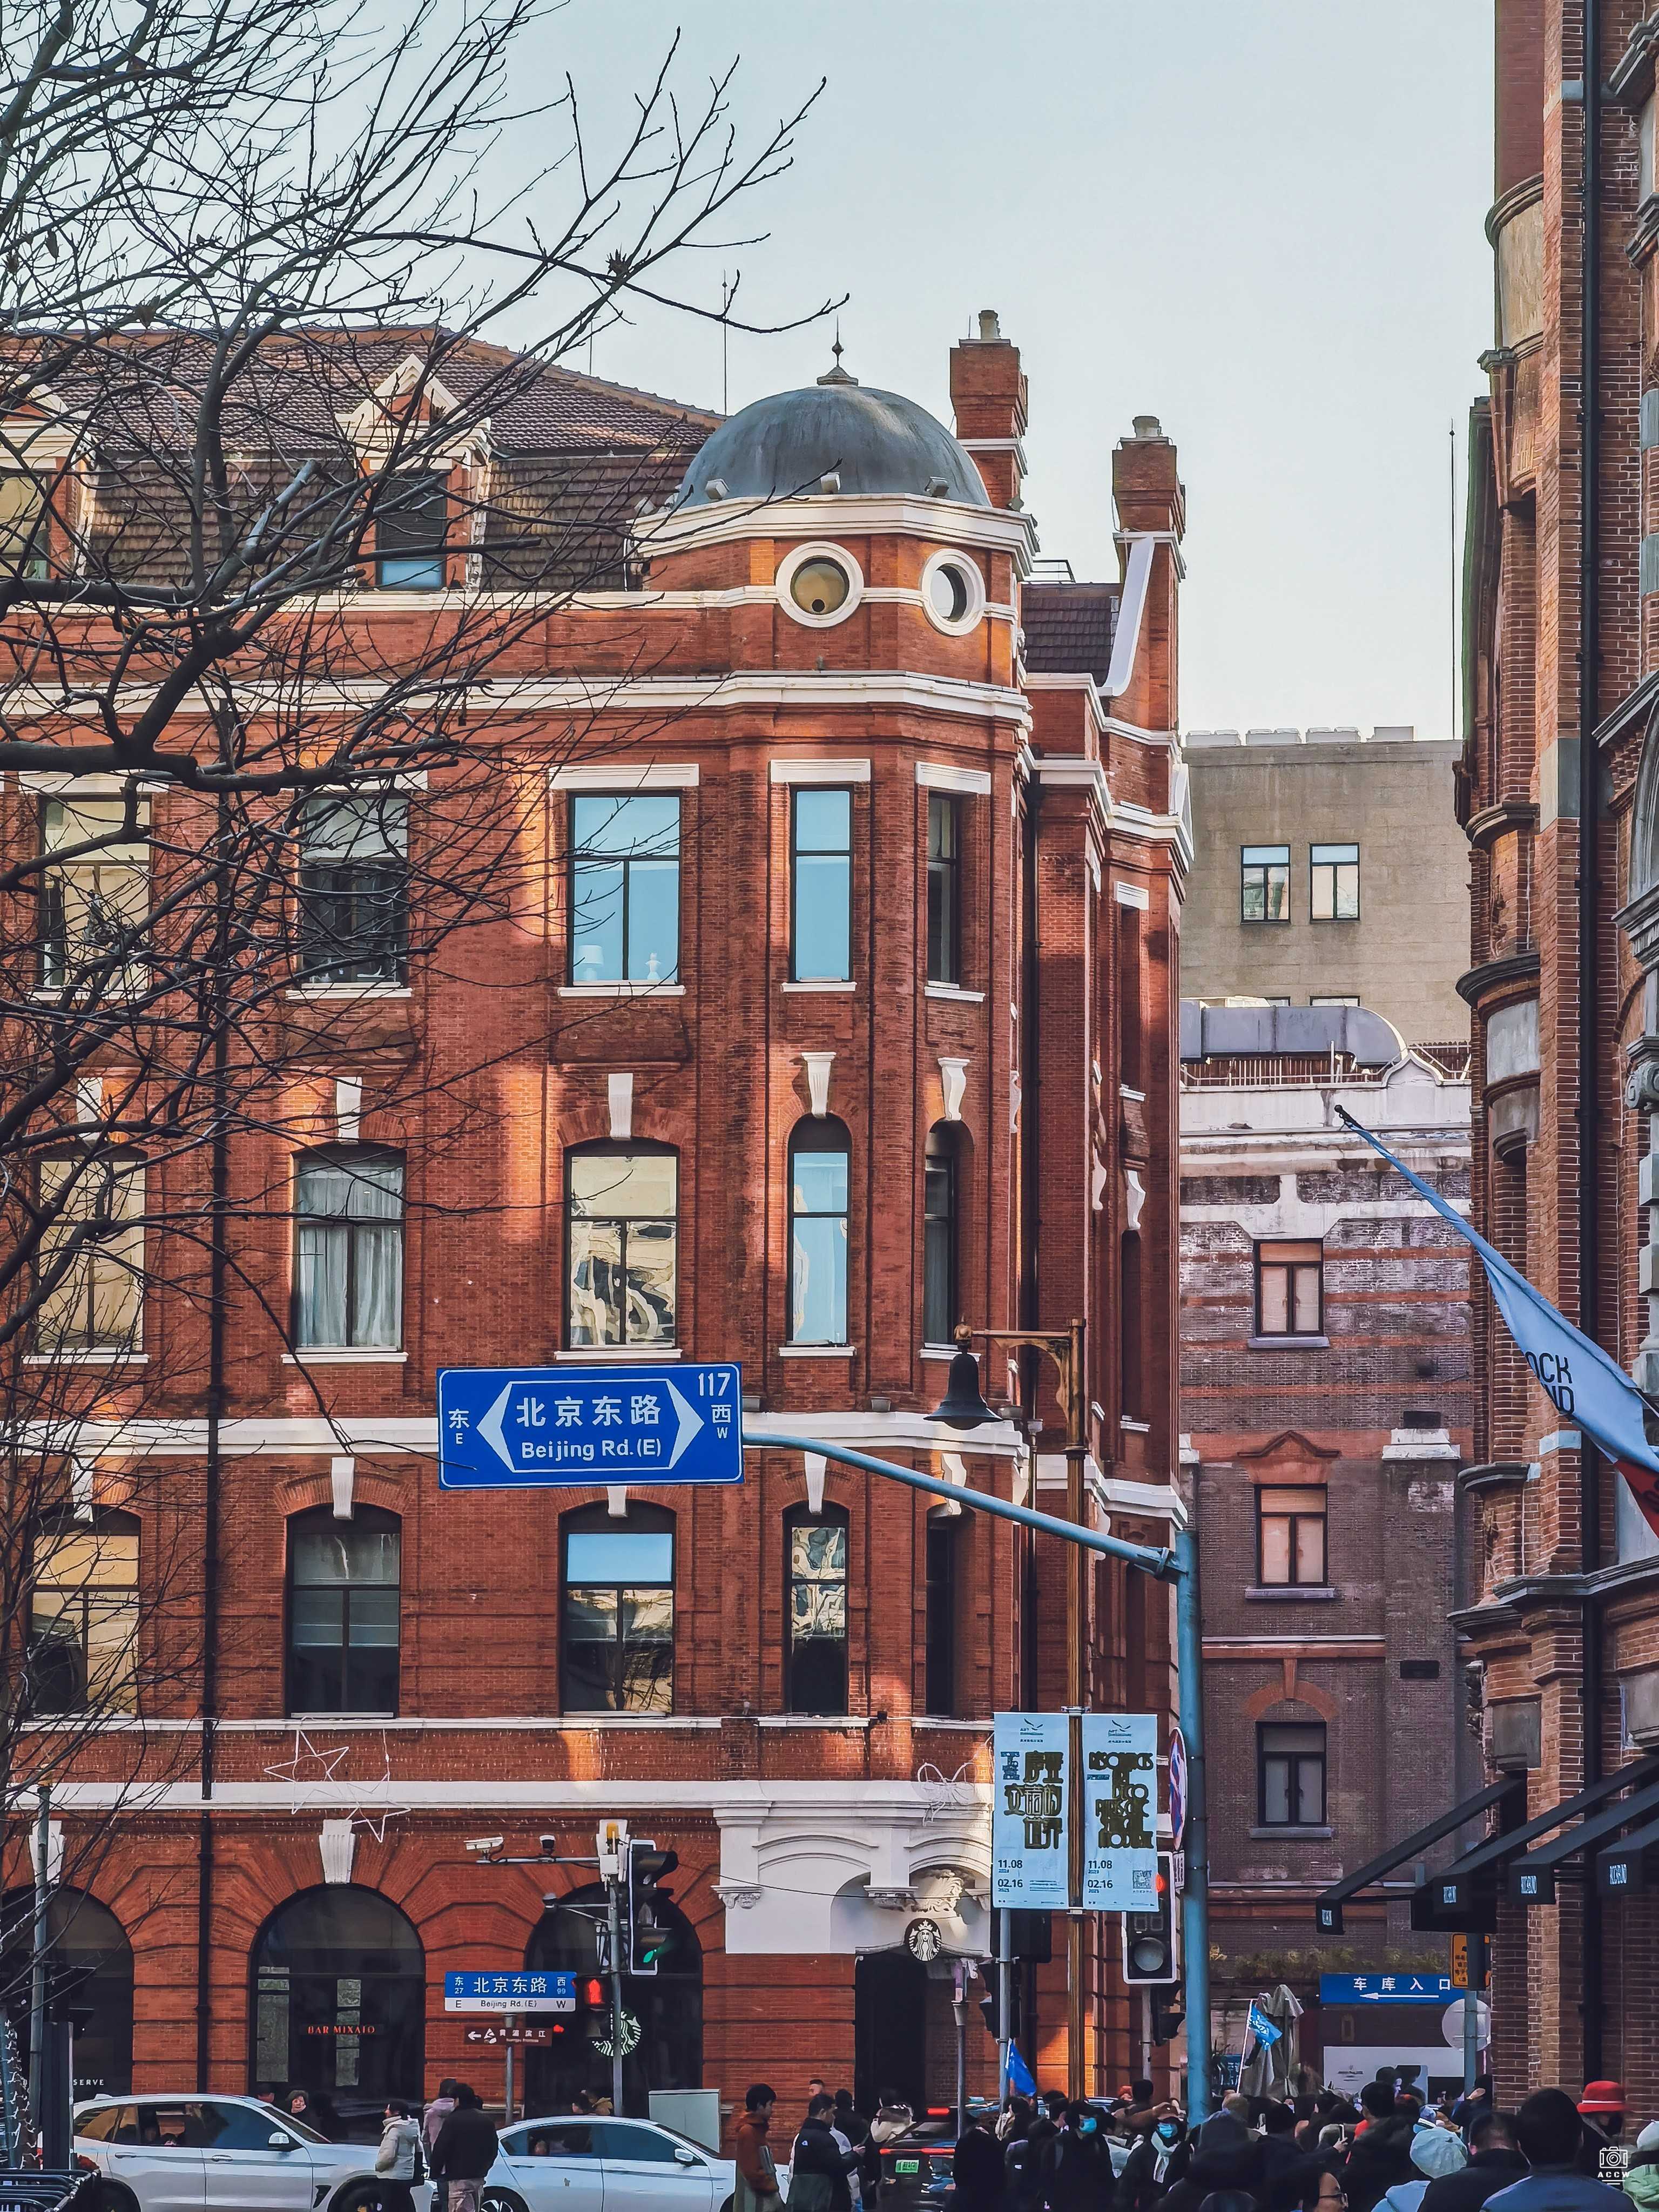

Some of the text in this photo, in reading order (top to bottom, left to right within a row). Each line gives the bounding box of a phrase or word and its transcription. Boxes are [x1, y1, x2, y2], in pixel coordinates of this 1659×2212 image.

[698, 1373, 730, 1397] 117
[516, 1394, 660, 1427] 北京东路
[711, 1404, 731, 1424] 西
[449, 1408, 469, 1429] 东
[456, 1433, 463, 1445] E
[717, 1427, 728, 1439] W
[521, 1441, 594, 1461] Beijing
[998, 1859, 1023, 1869] 11.08
[1088, 1860, 1112, 1869] 11.08
[997, 1878, 1023, 1888] 02.16
[1088, 1879, 1113, 1889] 02.16
[454, 1976, 567, 1994] 东 北京东路 西
[1353, 1977, 1451, 1991] 车库入口
[455, 2000, 462, 2008] E
[481, 2000, 507, 2008] Beijing
[556, 2000, 566, 2008] W
